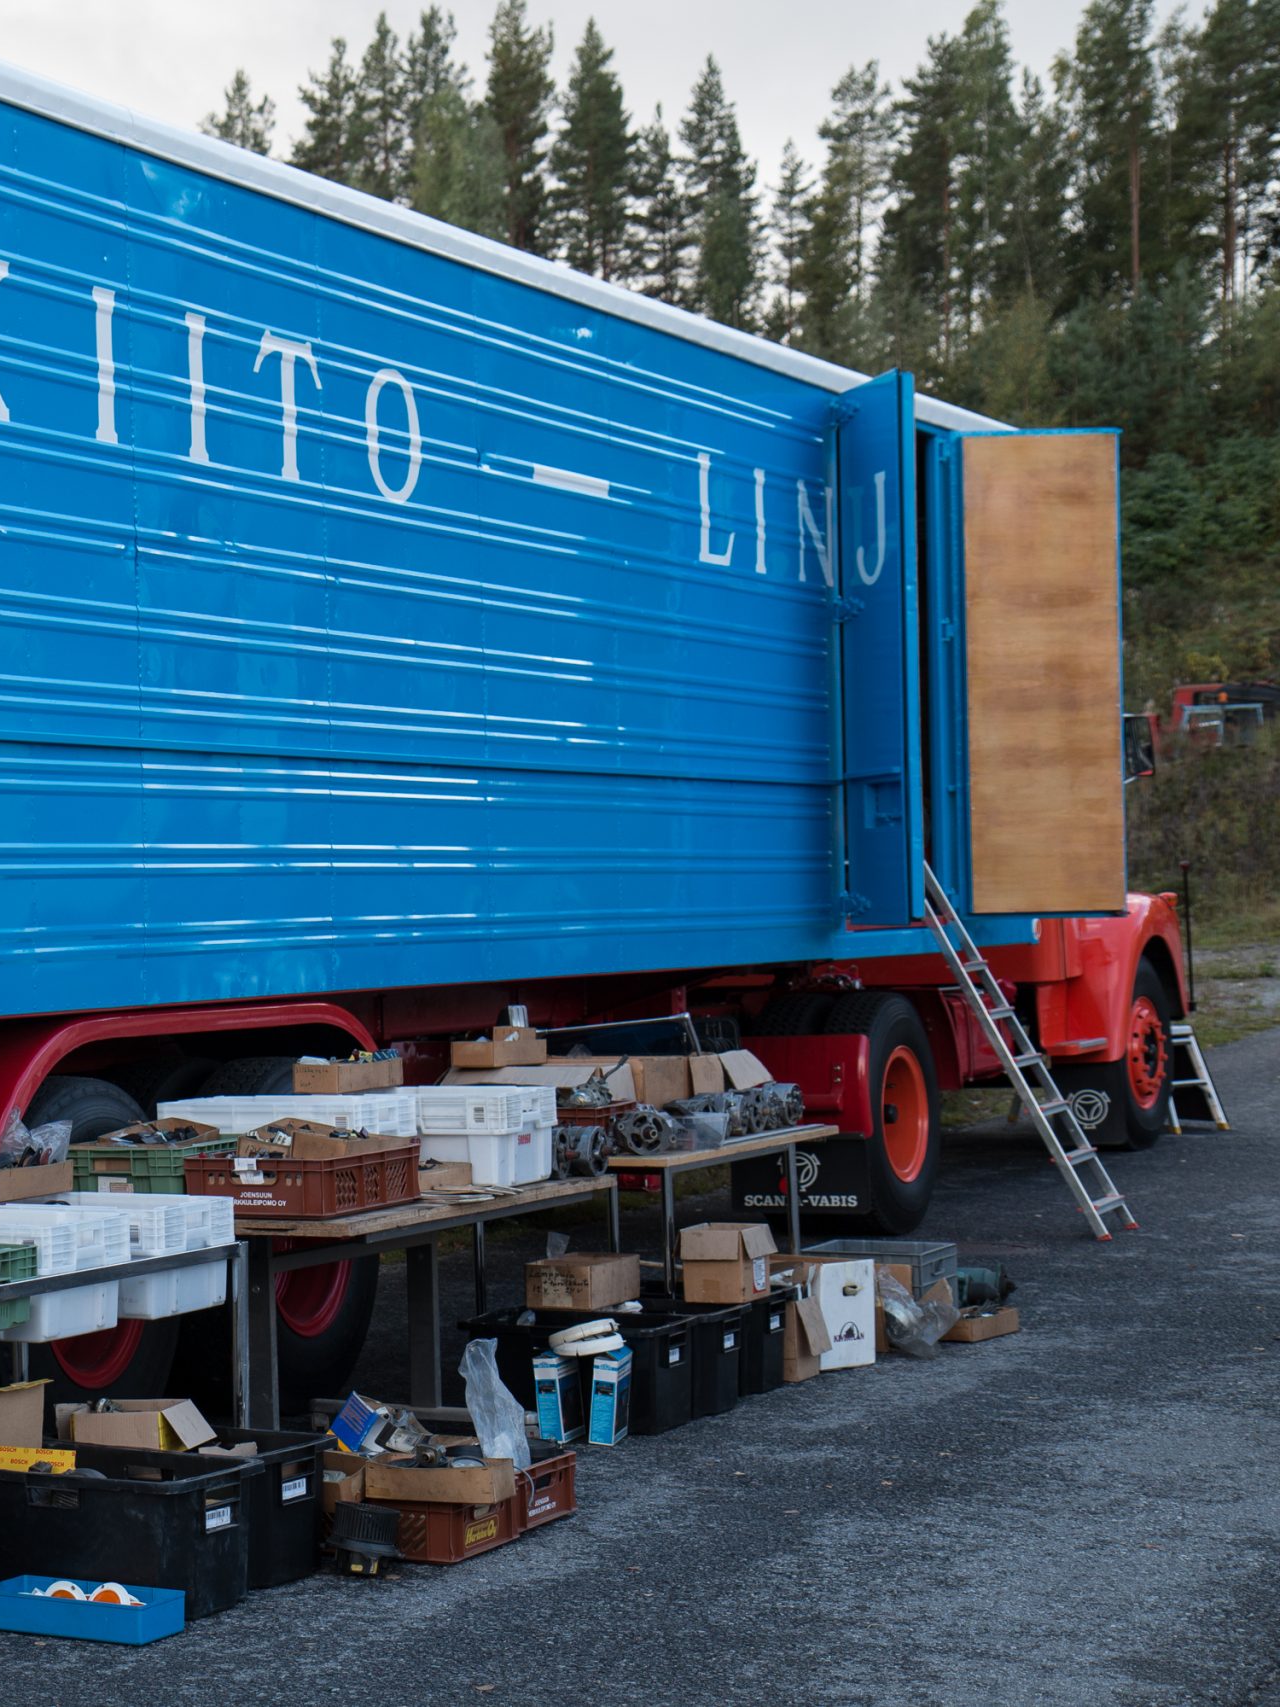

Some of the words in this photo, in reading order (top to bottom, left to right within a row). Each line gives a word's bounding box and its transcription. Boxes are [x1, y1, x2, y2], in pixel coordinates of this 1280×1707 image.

[240, 1191, 273, 1199] JOENSUUN
[233, 1199, 277, 1207] RKKULEIPOMO
[743, 1194, 859, 1208] SCAN-VABIS
